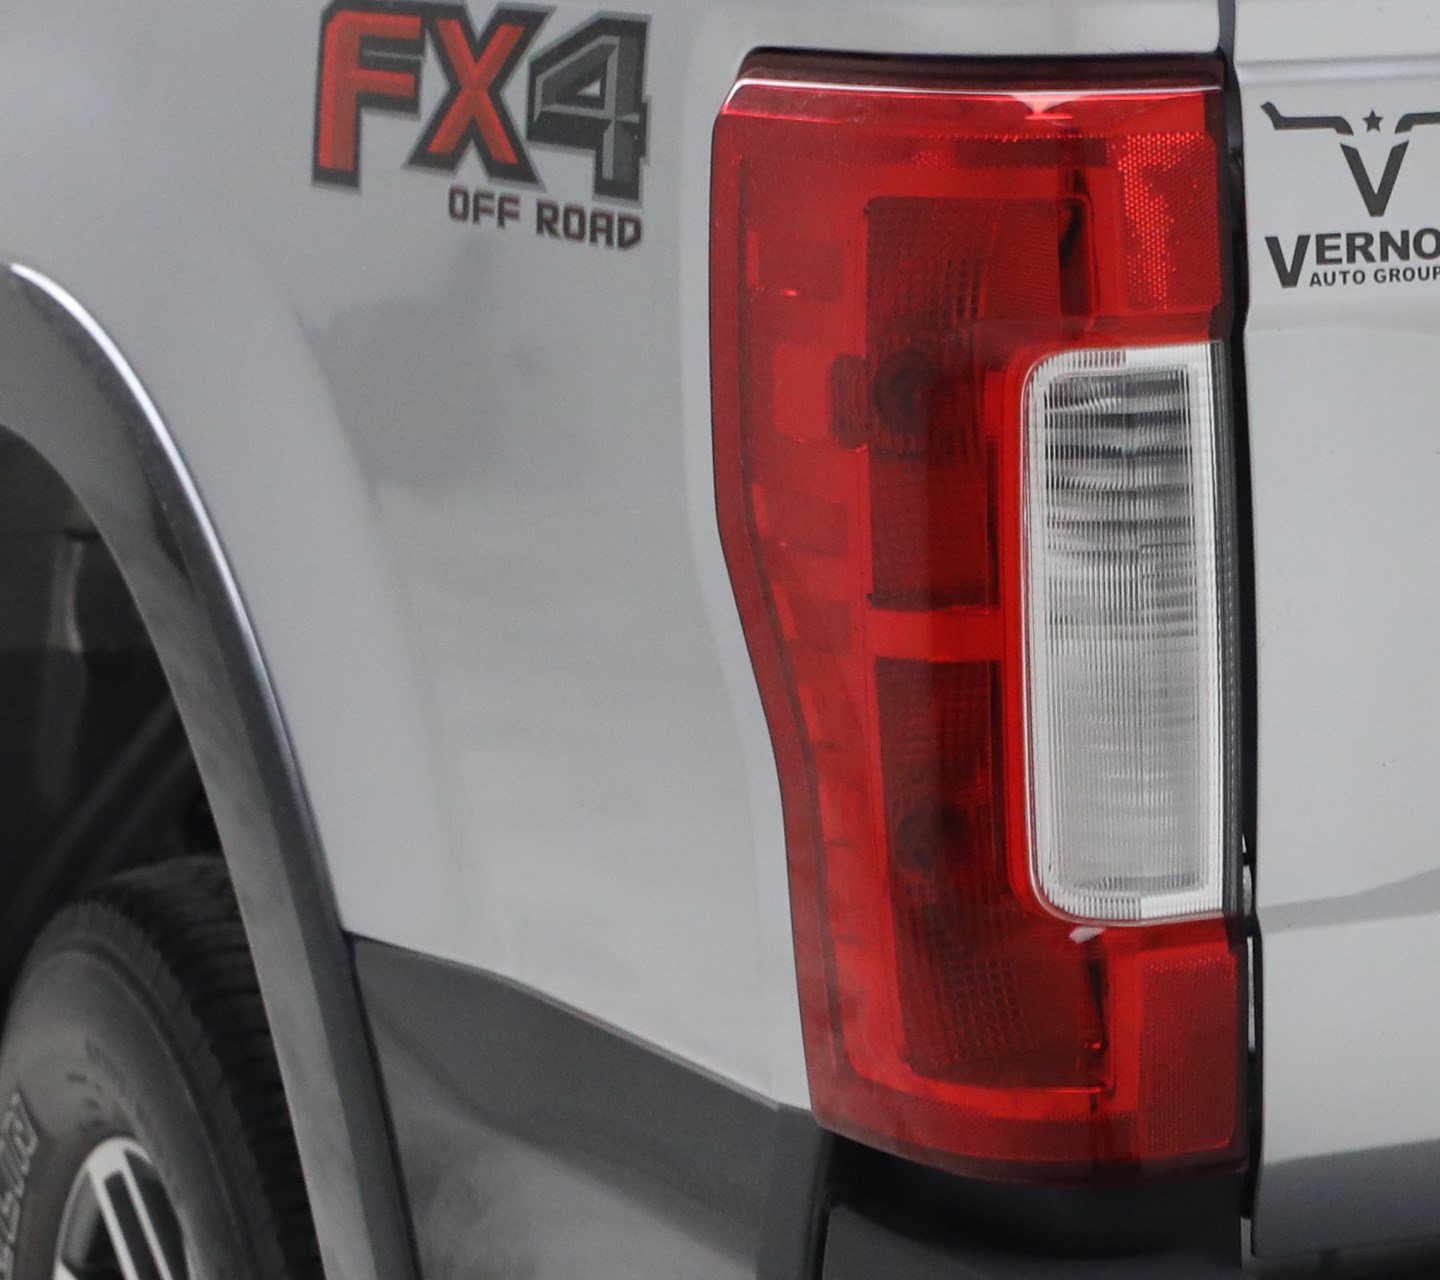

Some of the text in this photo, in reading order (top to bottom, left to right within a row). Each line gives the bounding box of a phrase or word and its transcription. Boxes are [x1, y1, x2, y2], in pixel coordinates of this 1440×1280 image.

[448, 184, 643, 251] OFF ROAD
[1309, 270, 1366, 288] AUTO
